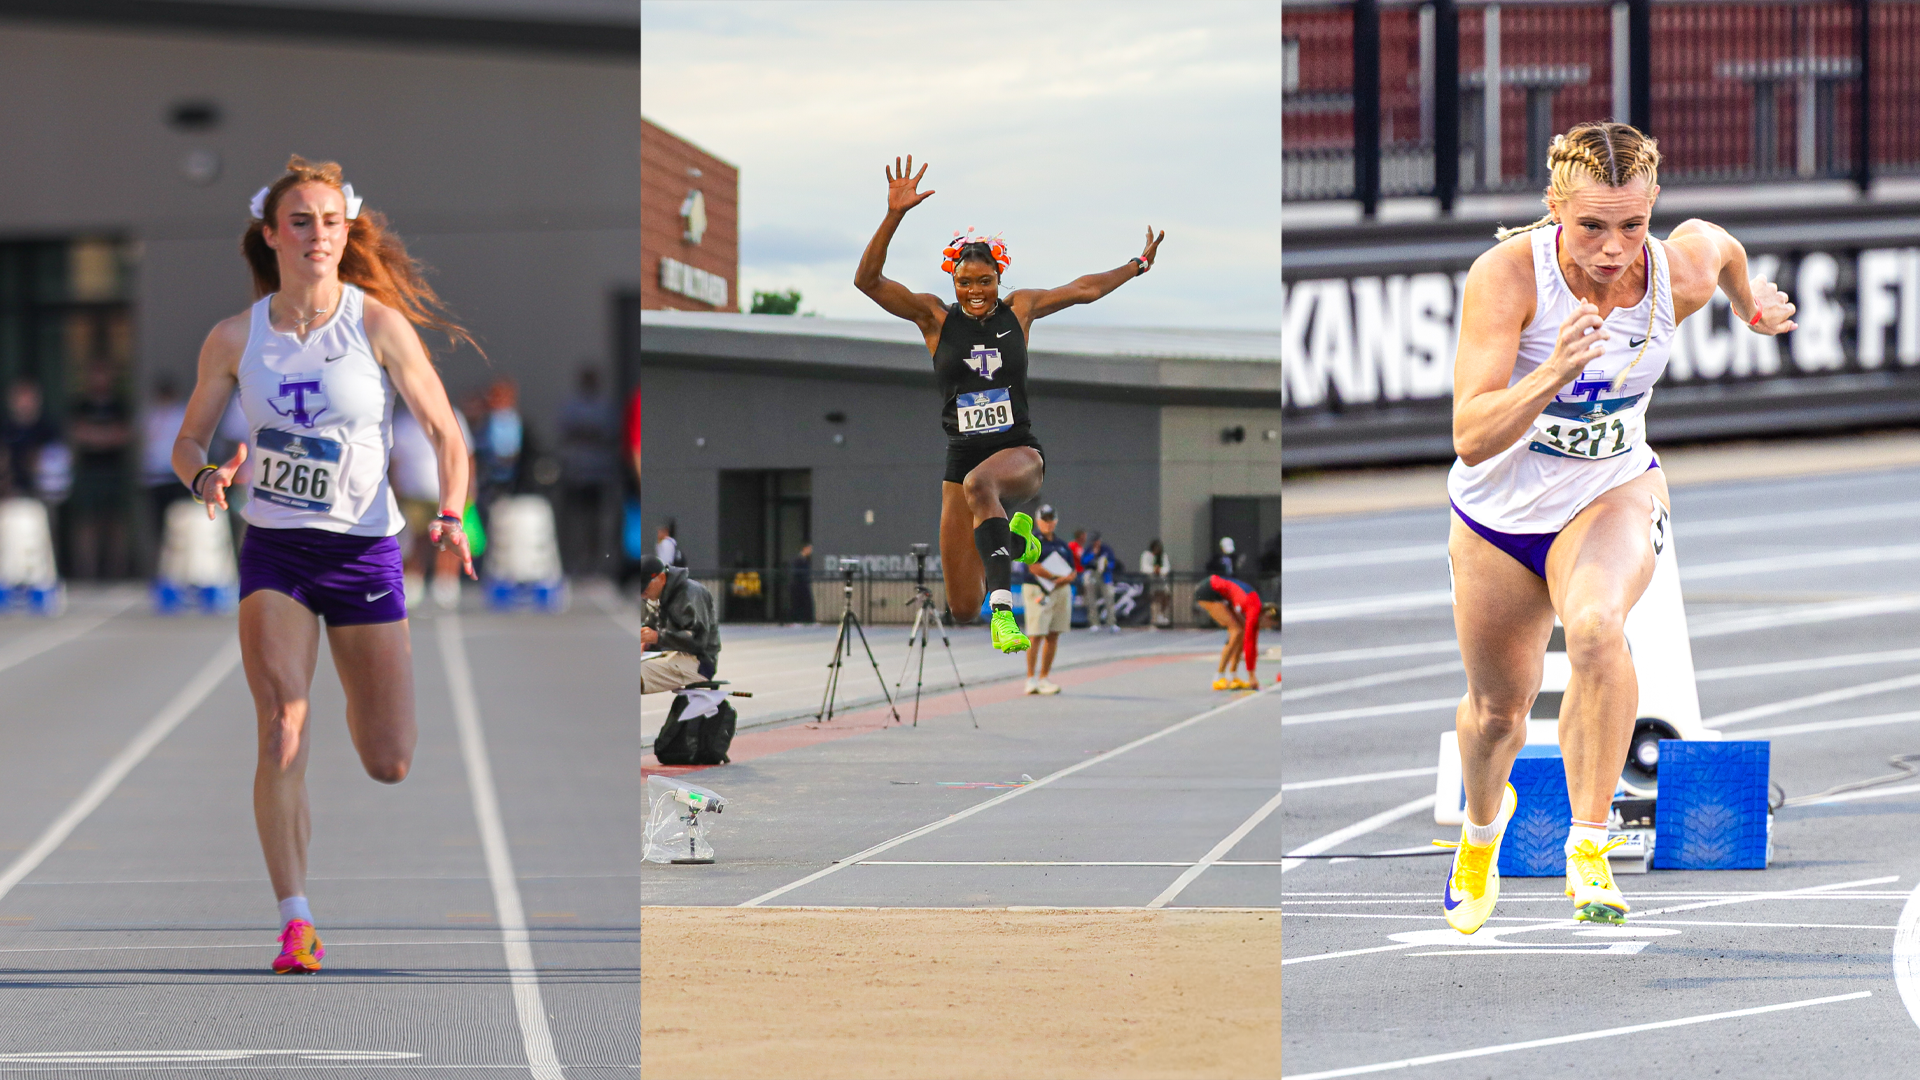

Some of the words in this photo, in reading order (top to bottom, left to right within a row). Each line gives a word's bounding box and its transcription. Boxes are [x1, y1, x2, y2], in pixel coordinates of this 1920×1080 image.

[1791, 252, 1847, 372] &
[971, 347, 999, 377] T
[279, 379, 323, 425] T
[964, 405, 1008, 430] 1269
[1546, 419, 1626, 457] 1271
[260, 457, 330, 500] 1266
